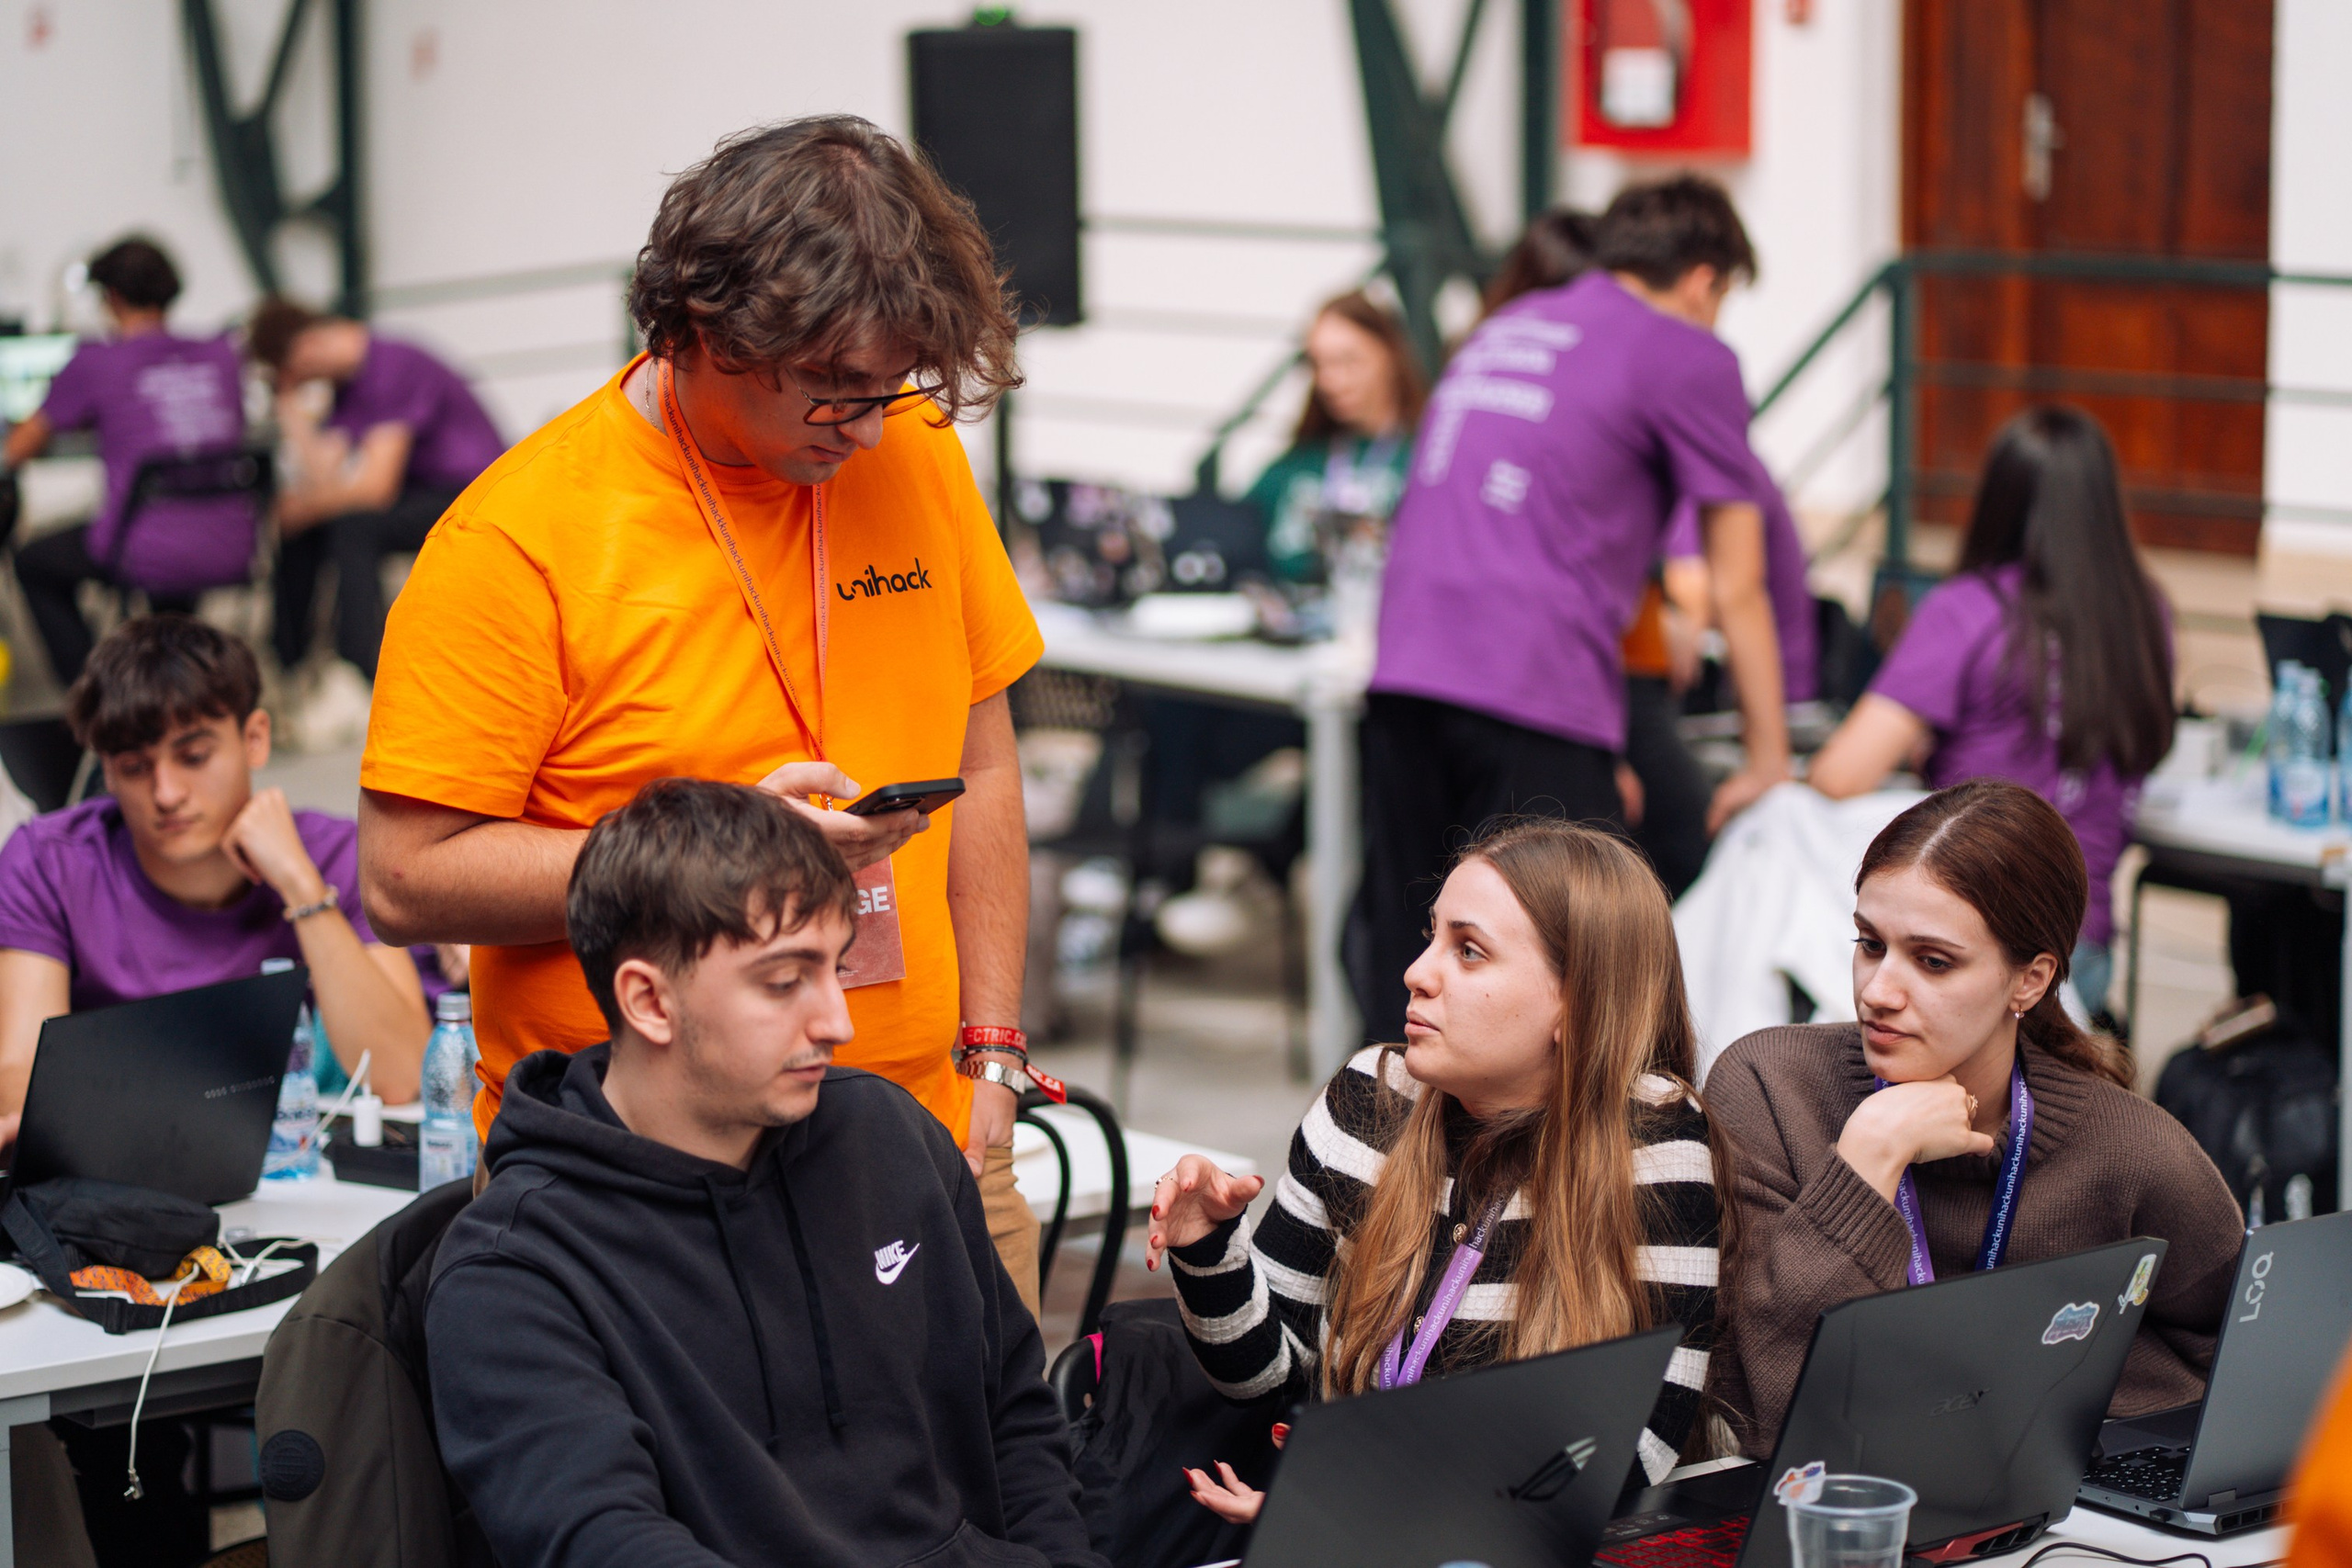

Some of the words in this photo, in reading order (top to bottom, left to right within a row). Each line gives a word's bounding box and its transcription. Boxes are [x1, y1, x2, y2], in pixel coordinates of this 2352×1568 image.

[836, 557, 933, 601] unihack
[875, 1240, 908, 1269] NIKE
[2239, 1251, 2274, 1323] LOQ
